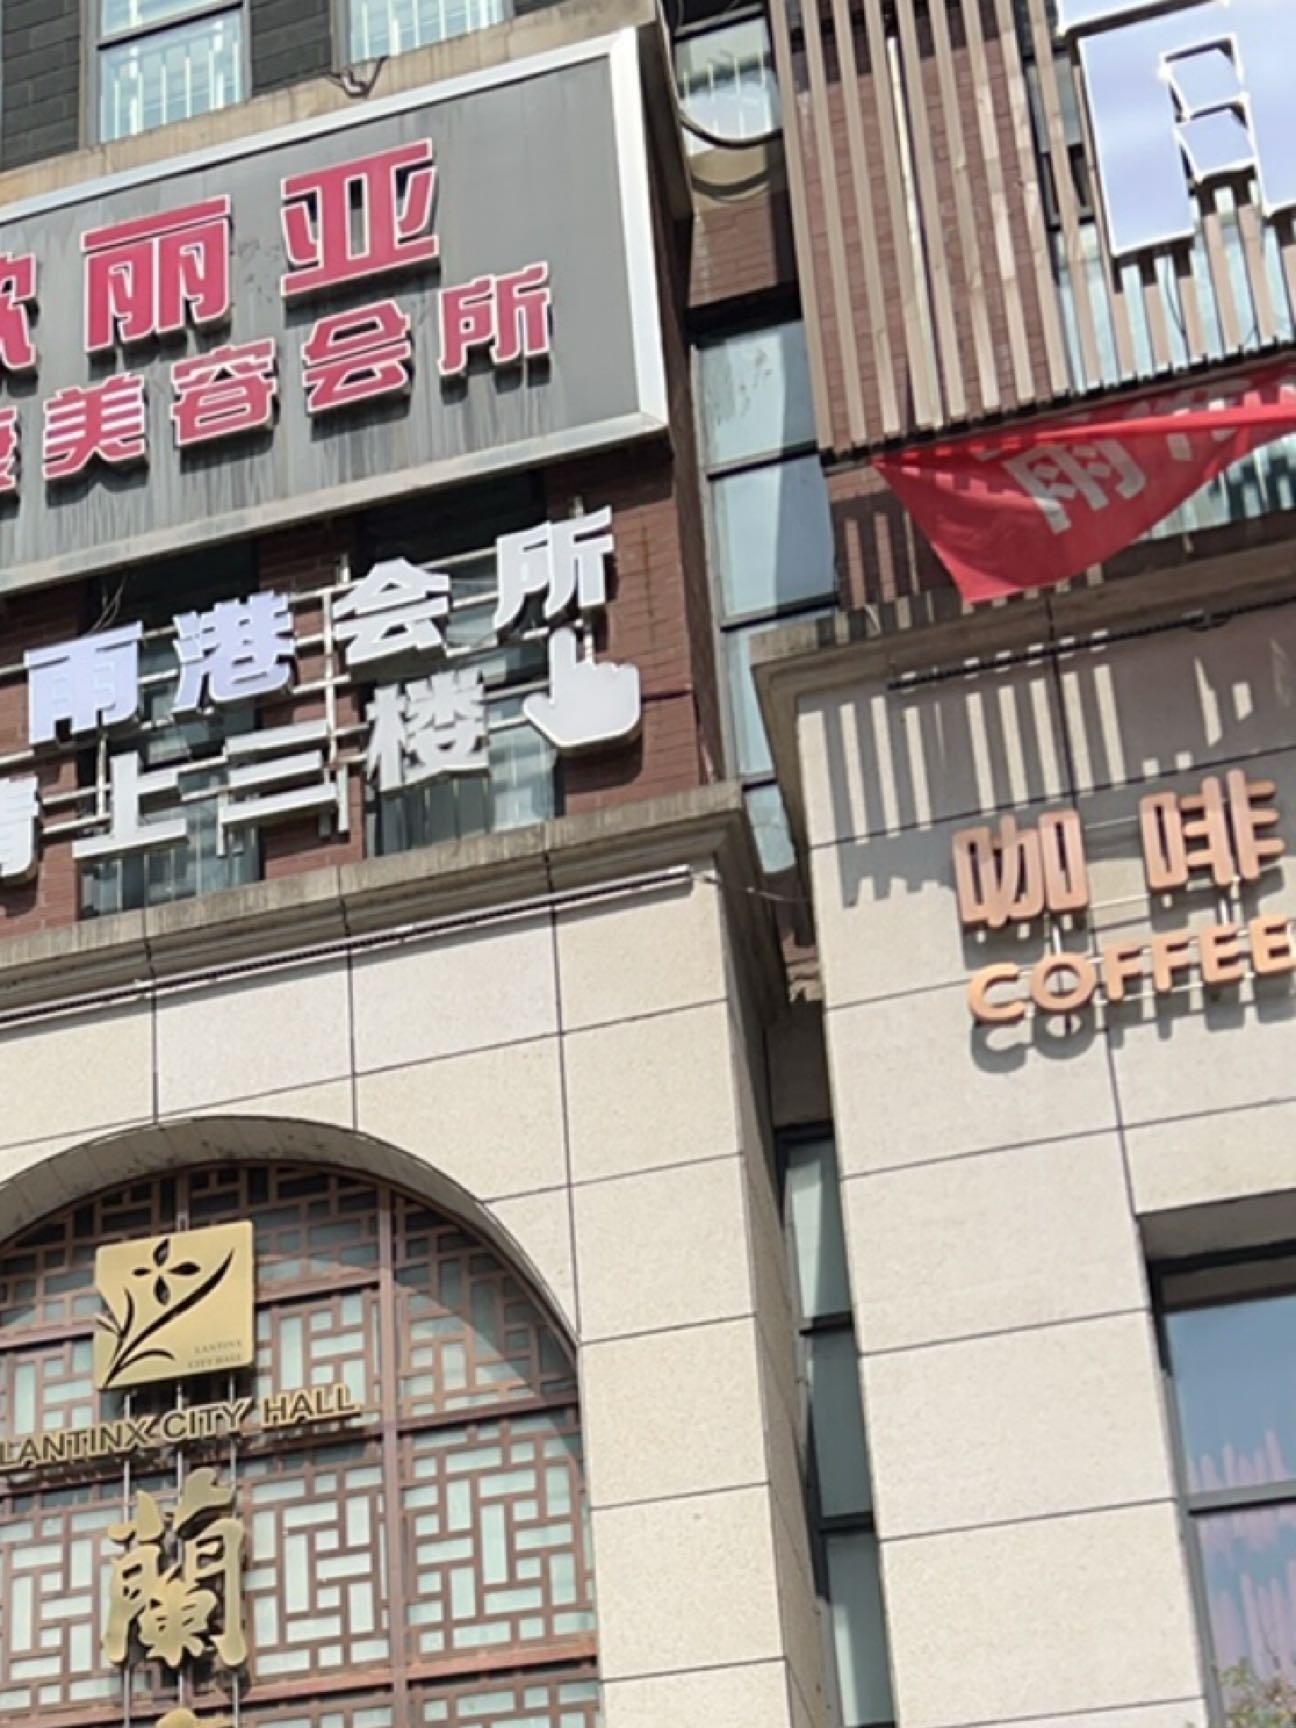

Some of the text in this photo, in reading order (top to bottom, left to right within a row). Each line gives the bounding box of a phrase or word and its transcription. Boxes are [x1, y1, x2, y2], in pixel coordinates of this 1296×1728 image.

[952, 769, 1286, 929] 咖啡
[968, 913, 1296, 1024] COFFEE
[162, 1397, 252, 1440] CITY
[261, 1382, 361, 1428] HALL
